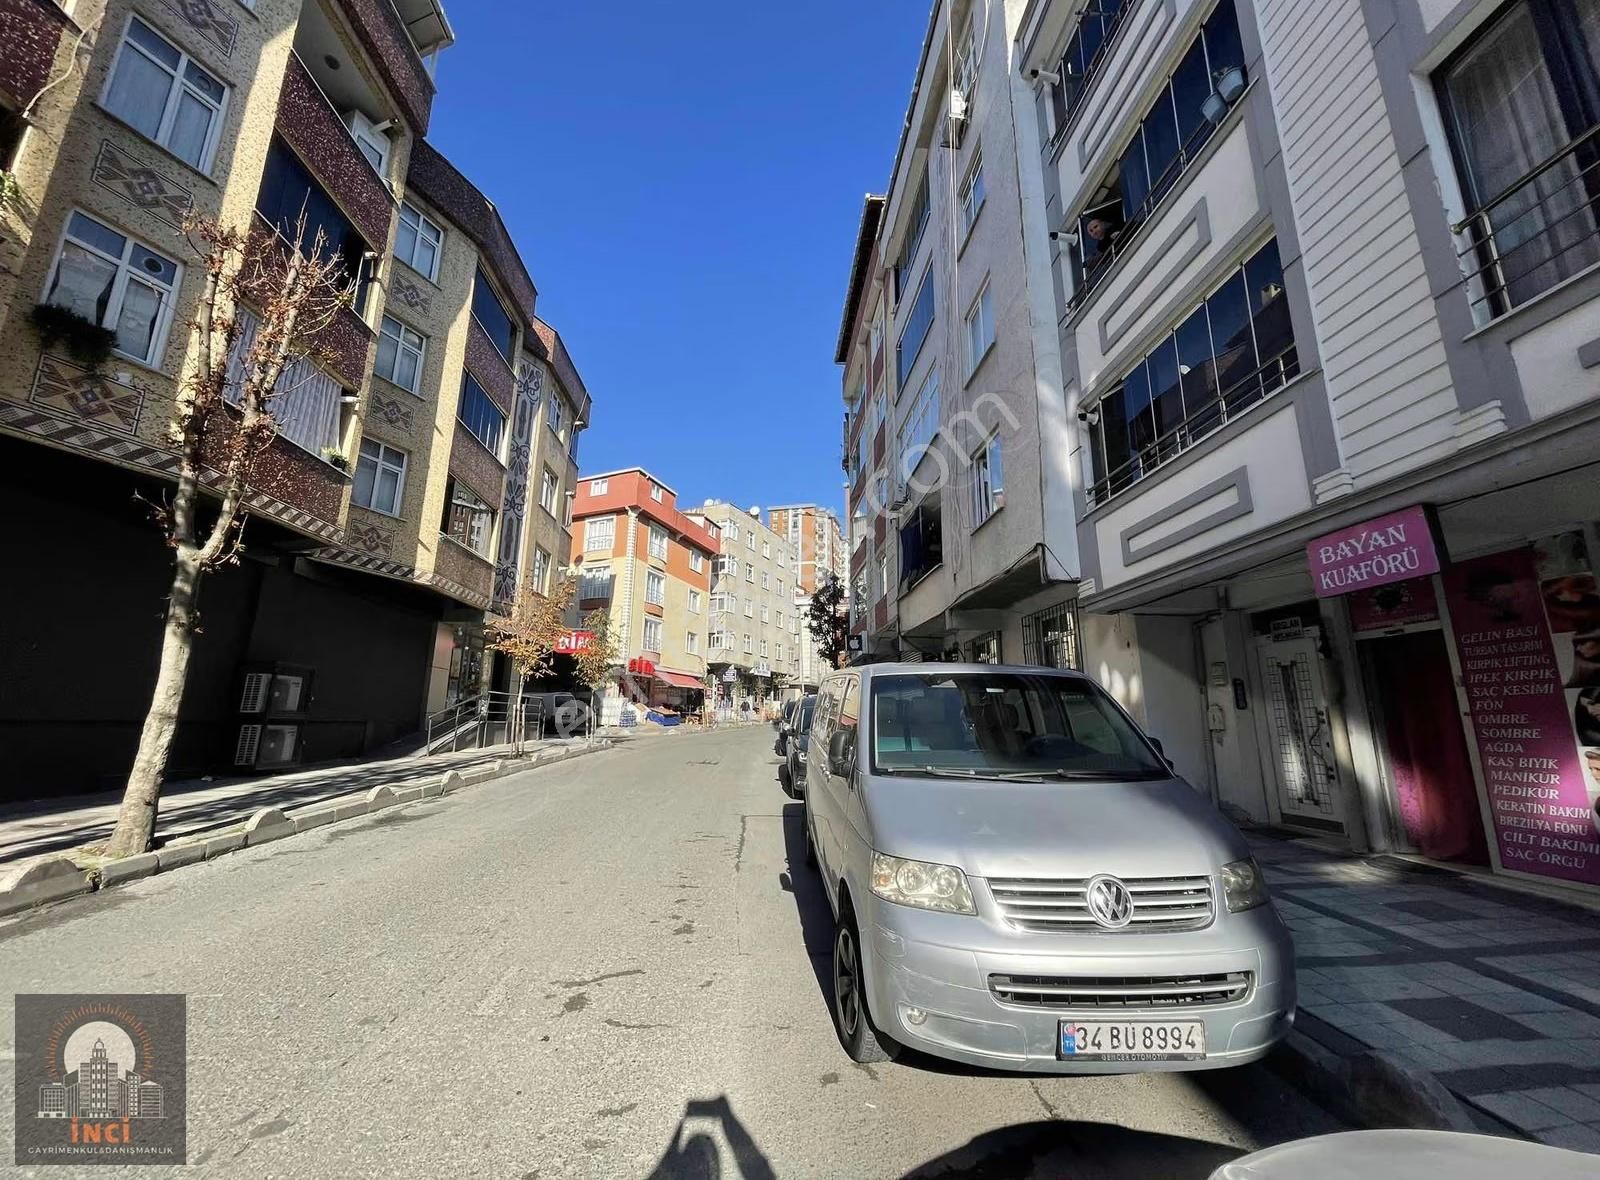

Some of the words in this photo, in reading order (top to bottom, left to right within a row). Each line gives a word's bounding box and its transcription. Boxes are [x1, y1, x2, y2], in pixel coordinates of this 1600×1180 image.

[1319, 524, 1407, 564] BAYAN
[1320, 546, 1420, 589] KUAFÖRÜ
[1479, 713, 1529, 724] OMBRE
[1481, 728, 1542, 739] SOMBRE
[1549, 805, 1591, 819] BAKIM
[1076, 1027, 1102, 1050] 34
[1143, 1025, 1196, 1049] 8994
